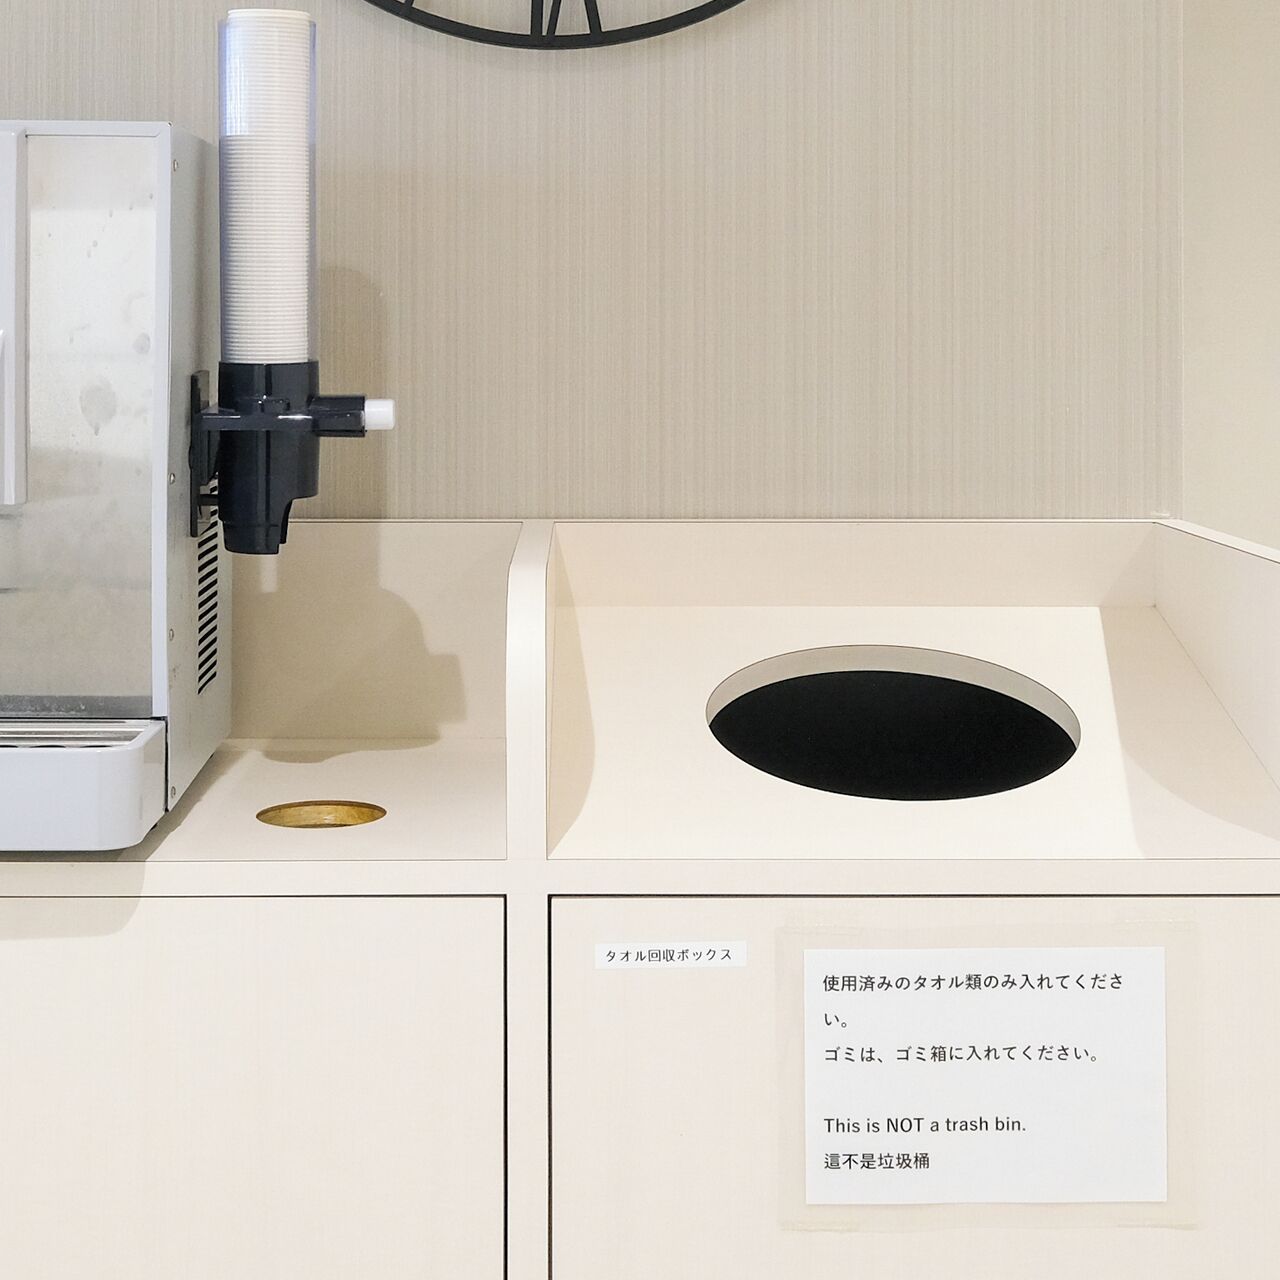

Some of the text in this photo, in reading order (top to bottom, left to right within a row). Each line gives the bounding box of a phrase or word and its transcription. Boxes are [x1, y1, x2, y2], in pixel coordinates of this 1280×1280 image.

[606, 948, 733, 963] タオル回収ボックス
[822, 973, 1124, 992] 使用済みのタオル類のみ入れてくださ
[824, 1012, 849, 1029] い。
[824, 1044, 1098, 1064] ゴミは、ゴミ箱に入れてください。
[823, 1116, 1027, 1134] This is NOT a trash bin.
[823, 1152, 931, 1170] 這不是垃圾桶
